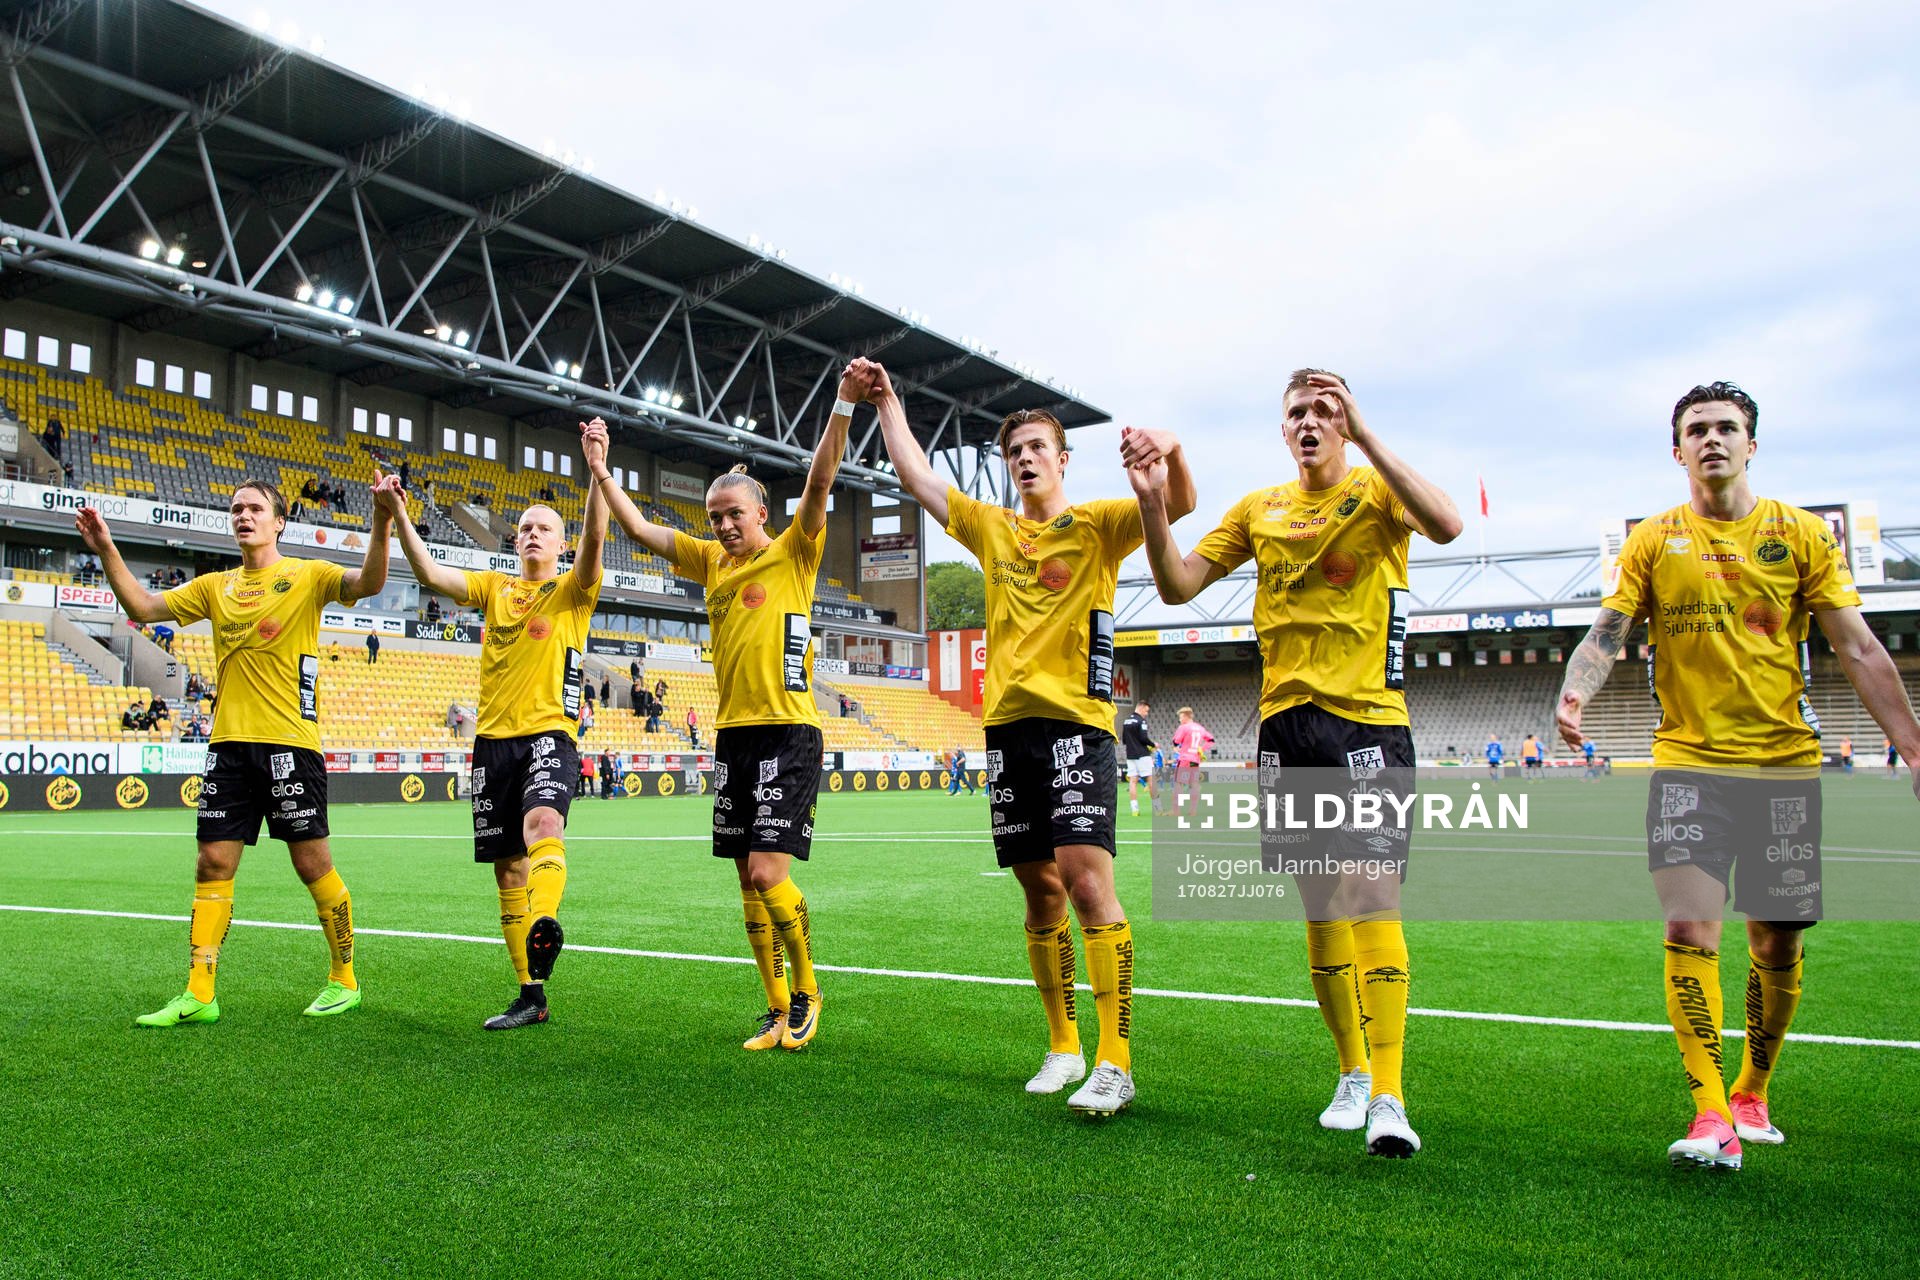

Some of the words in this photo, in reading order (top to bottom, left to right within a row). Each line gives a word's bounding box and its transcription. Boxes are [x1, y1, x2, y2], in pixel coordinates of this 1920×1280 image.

[1705, 571, 1741, 581] STAPLES
[61, 588, 114, 604] SPEED
[1662, 601, 1736, 617] Swedbank
[1664, 618, 1725, 636] Sjuhärad
[1056, 737, 1077, 749] EFF
[1056, 744, 1081, 759] EKT
[1350, 750, 1376, 764] EFF
[273, 754, 289, 764] EFF
[273, 761, 292, 771] EKT
[529, 755, 561, 774] ellos
[1352, 758, 1381, 773] EKT
[1052, 767, 1094, 788] ellos
[271, 781, 305, 797] ellos
[1665, 786, 1693, 797] EFF
[1663, 795, 1695, 807] EKT
[1774, 800, 1800, 812] EFF
[1663, 805, 1678, 816] IV
[1774, 810, 1803, 823] EKT
[1652, 818, 1704, 843] ellos
[1775, 821, 1792, 833] IV
[1766, 838, 1814, 863] ellos
[1115, 939, 1133, 1040] SPRINGYARD
